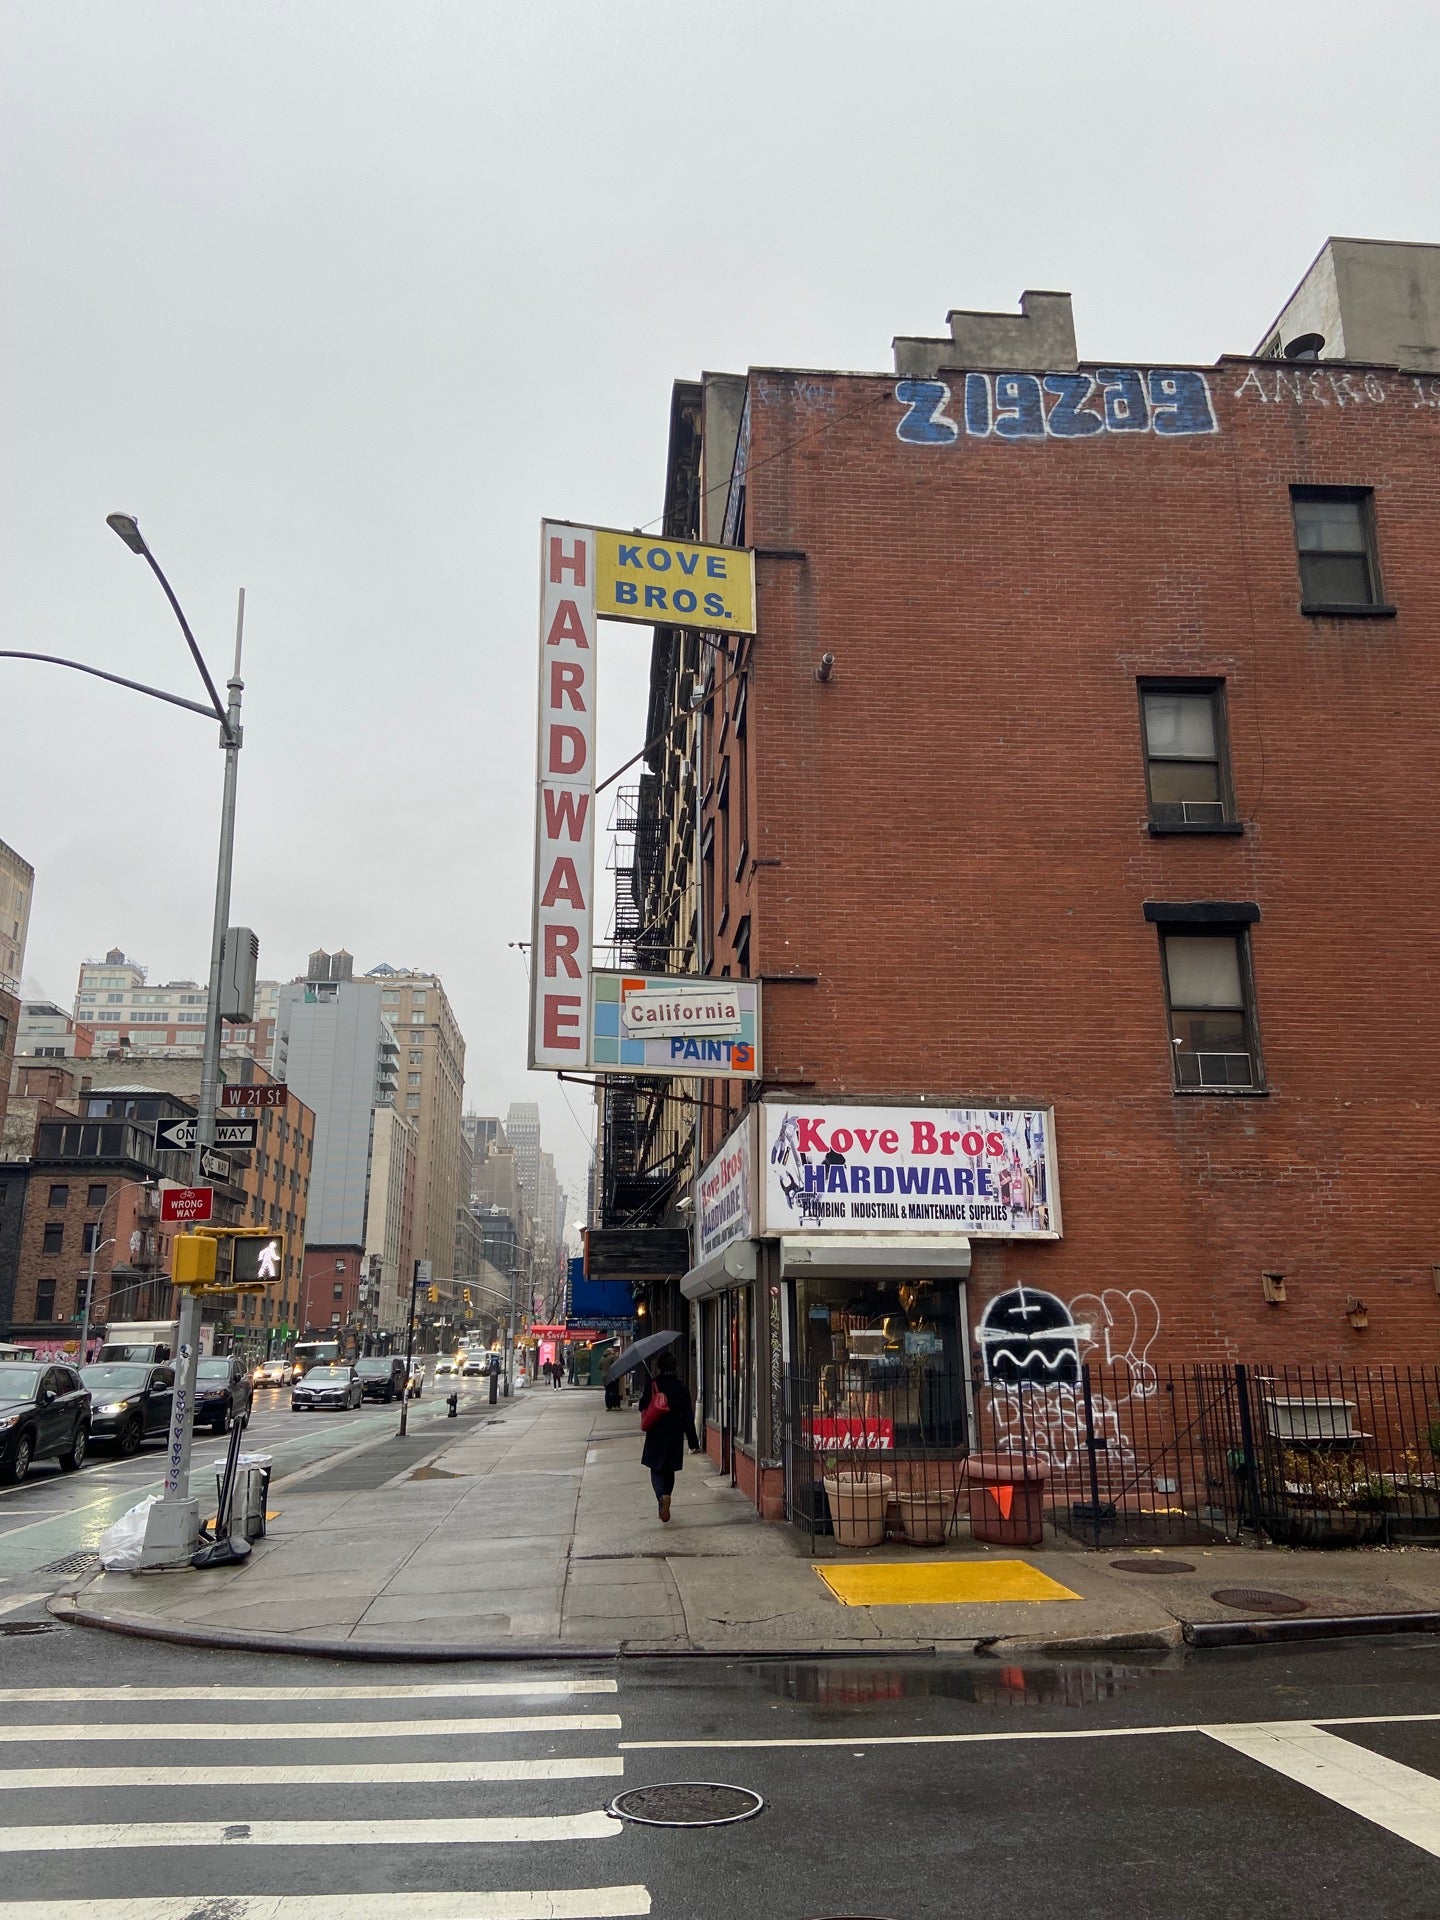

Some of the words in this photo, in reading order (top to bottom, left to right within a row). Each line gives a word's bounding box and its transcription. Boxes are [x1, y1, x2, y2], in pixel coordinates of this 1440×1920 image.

[618, 544, 727, 579] KOVE
[615, 581, 732, 618] BROS.
[541, 537, 589, 1050] HARDWARE
[631, 1003, 736, 1023] California
[671, 1037, 750, 1063] PAINTS
[229, 1090, 241, 1104] W
[247, 1090, 260, 1104] 21
[266, 1089, 281, 1104] St
[176, 1128, 198, 1140] ON
[218, 1128, 247, 1140] WAY
[797, 1118, 899, 1154] Kove
[910, 1121, 1004, 1157] Bros
[720, 1148, 743, 1191] Bros
[804, 1165, 994, 1196] HARDWARE
[171, 1199, 203, 1209] WRONG
[176, 1208, 197, 1218] WAY
[802, 1203, 846, 1218] PLUMBING
[851, 1203, 900, 1219] INDUSTRIAL
[901, 1206, 907, 1219] &
[908, 1203, 966, 1220] MAINTENANCE
[969, 1205, 1008, 1221] SUPPLIES
